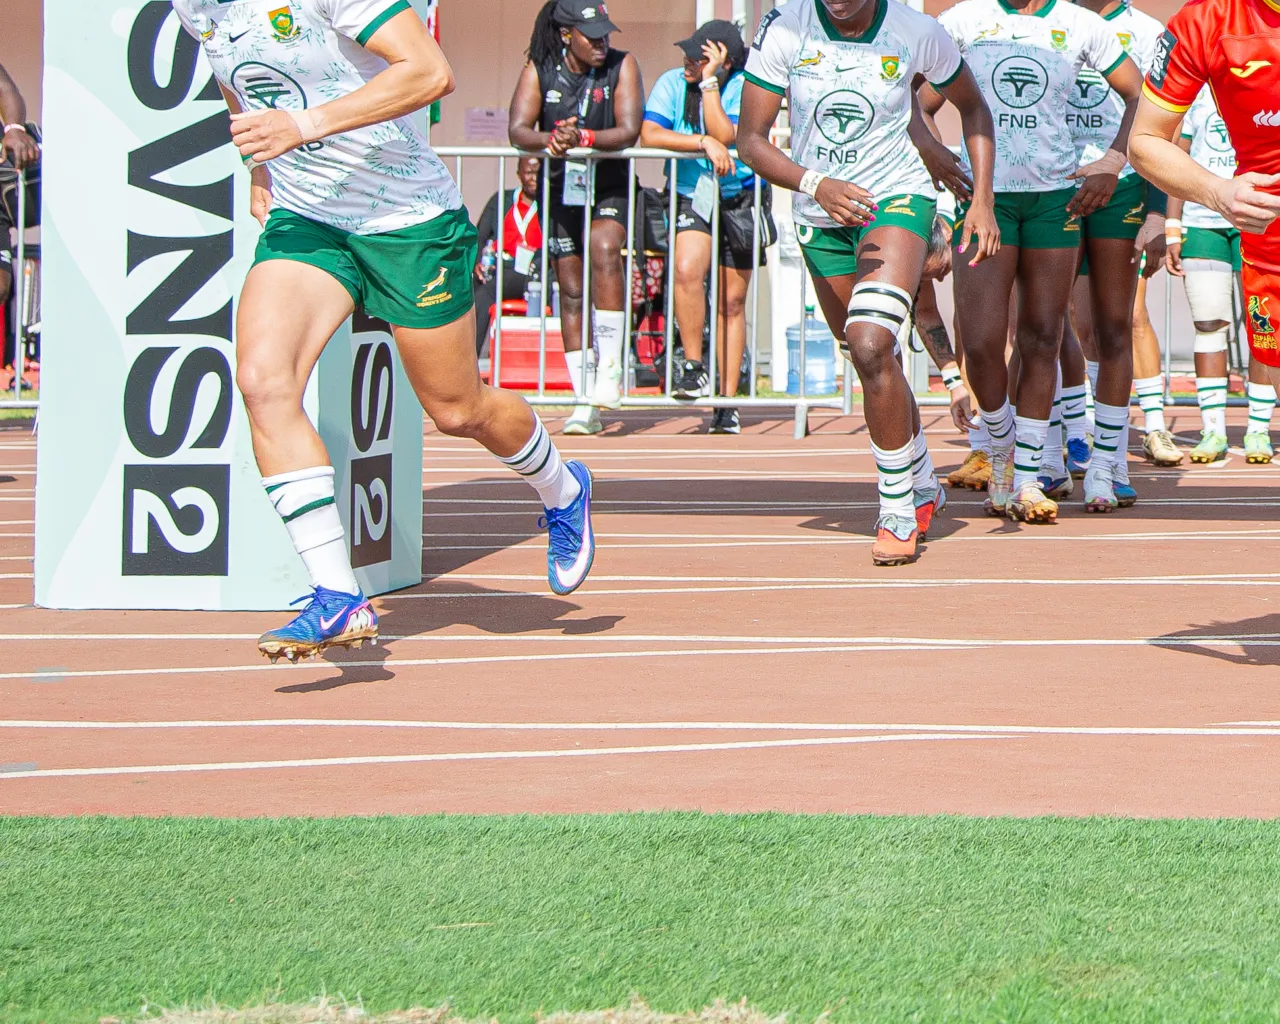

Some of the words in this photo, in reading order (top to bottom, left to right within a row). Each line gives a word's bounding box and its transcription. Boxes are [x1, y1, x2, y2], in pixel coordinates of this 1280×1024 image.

[999, 113, 1038, 129] FNB
[1066, 114, 1103, 128] FNB
[816, 146, 858, 164] FNB
